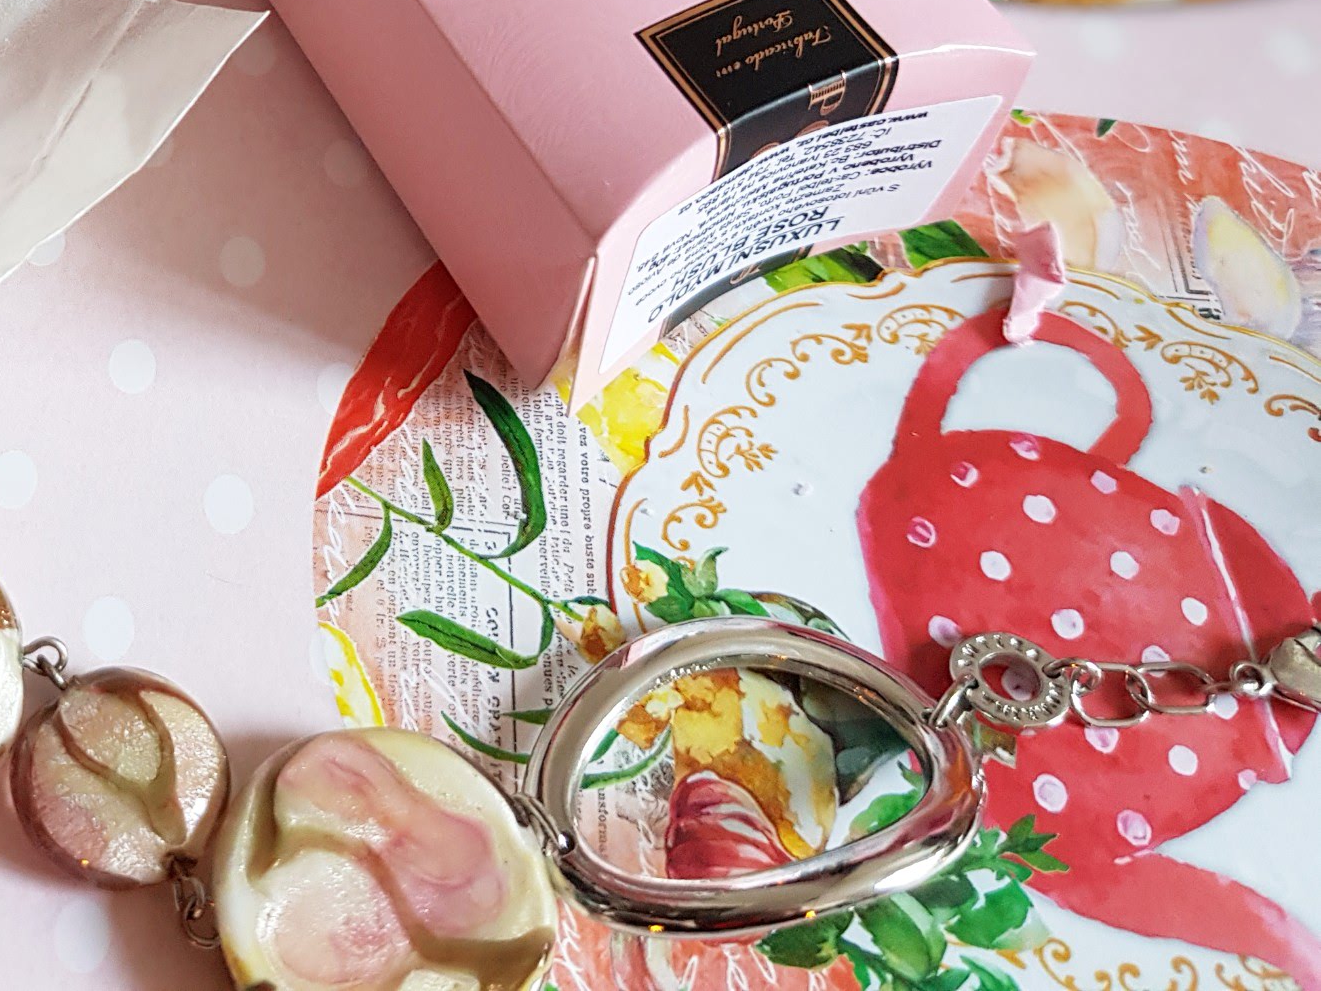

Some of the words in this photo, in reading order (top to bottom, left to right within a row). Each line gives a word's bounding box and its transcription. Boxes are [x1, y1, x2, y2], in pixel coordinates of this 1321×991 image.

[715, 9, 794, 57] Portugal
[745, 25, 832, 72] Fabricado
[724, 218, 841, 272] LUXUSNÍ
[753, 204, 830, 245] ROSÉ
[670, 234, 749, 292] BLUSH
[647, 260, 724, 325] MÝDLO
[554, 448, 569, 501] regarder
[578, 453, 591, 483] votre
[578, 488, 595, 529] propre
[583, 534, 596, 568] buste
